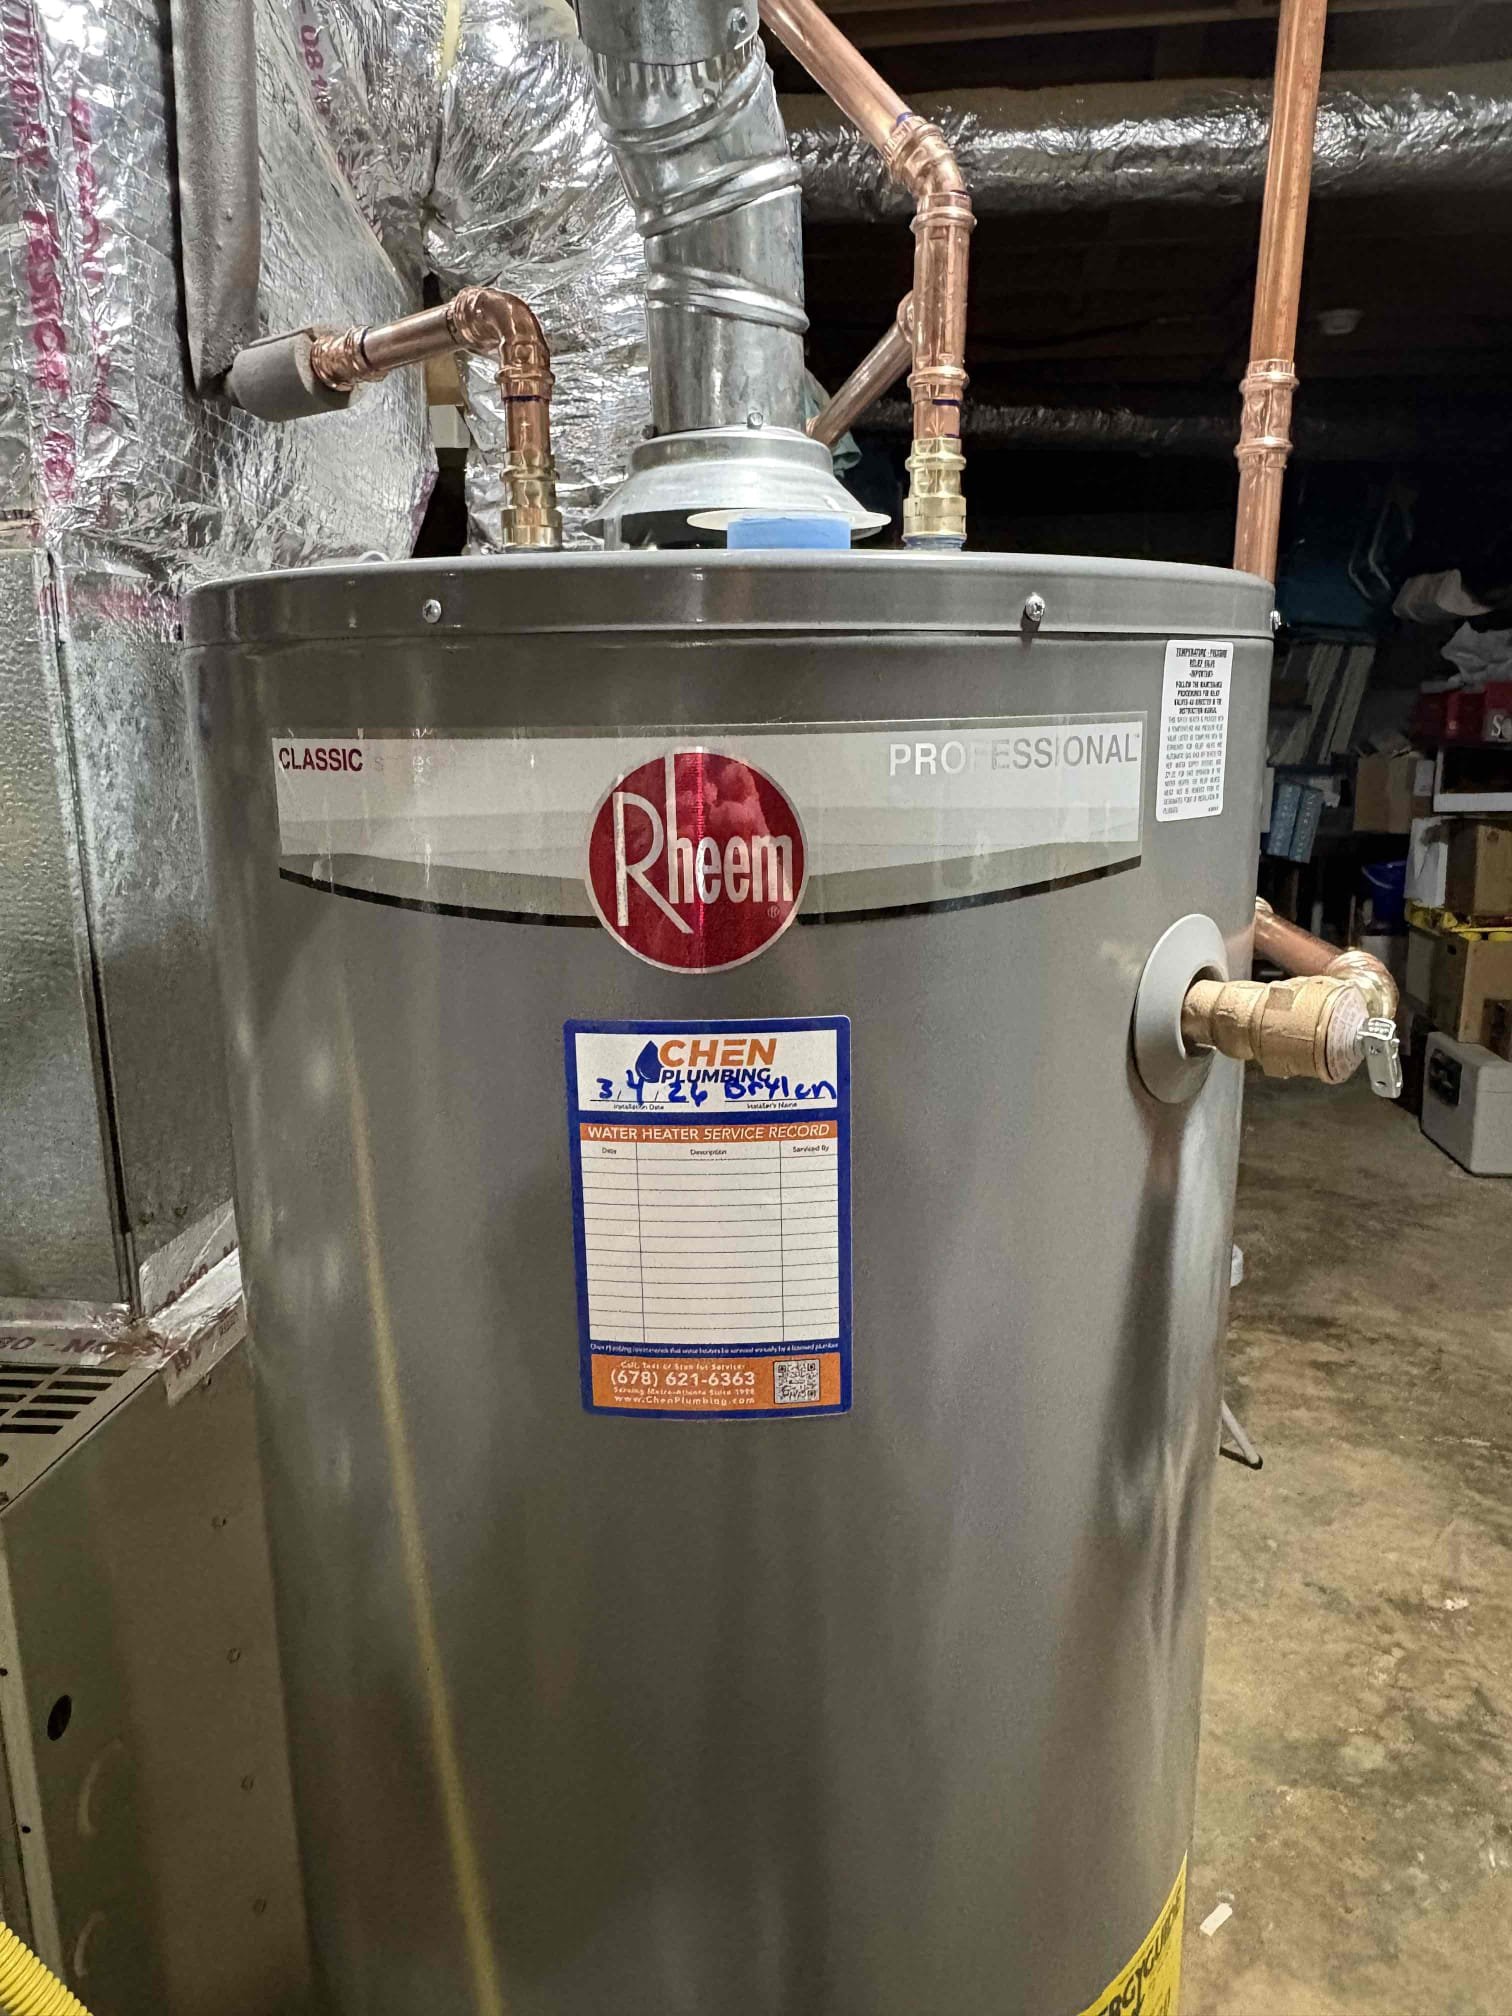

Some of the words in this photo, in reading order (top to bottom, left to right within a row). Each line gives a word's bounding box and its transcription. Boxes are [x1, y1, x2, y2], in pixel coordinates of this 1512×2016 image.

[278, 747, 363, 772] CLASSIC
[612, 749, 793, 934] Rheem
[659, 1038, 777, 1068] CHEN
[660, 1068, 772, 1084] PLUMBING
[588, 1126, 637, 1139] WATER
[642, 1128, 698, 1140] HEATER
[704, 1126, 764, 1140] SERVICE
[768, 1124, 830, 1138] RECORD
[610, 1370, 658, 1387] (678)
[666, 1370, 756, 1387] 621-6363
[614, 1396, 756, 1407] www.ChenPlumbing.com
